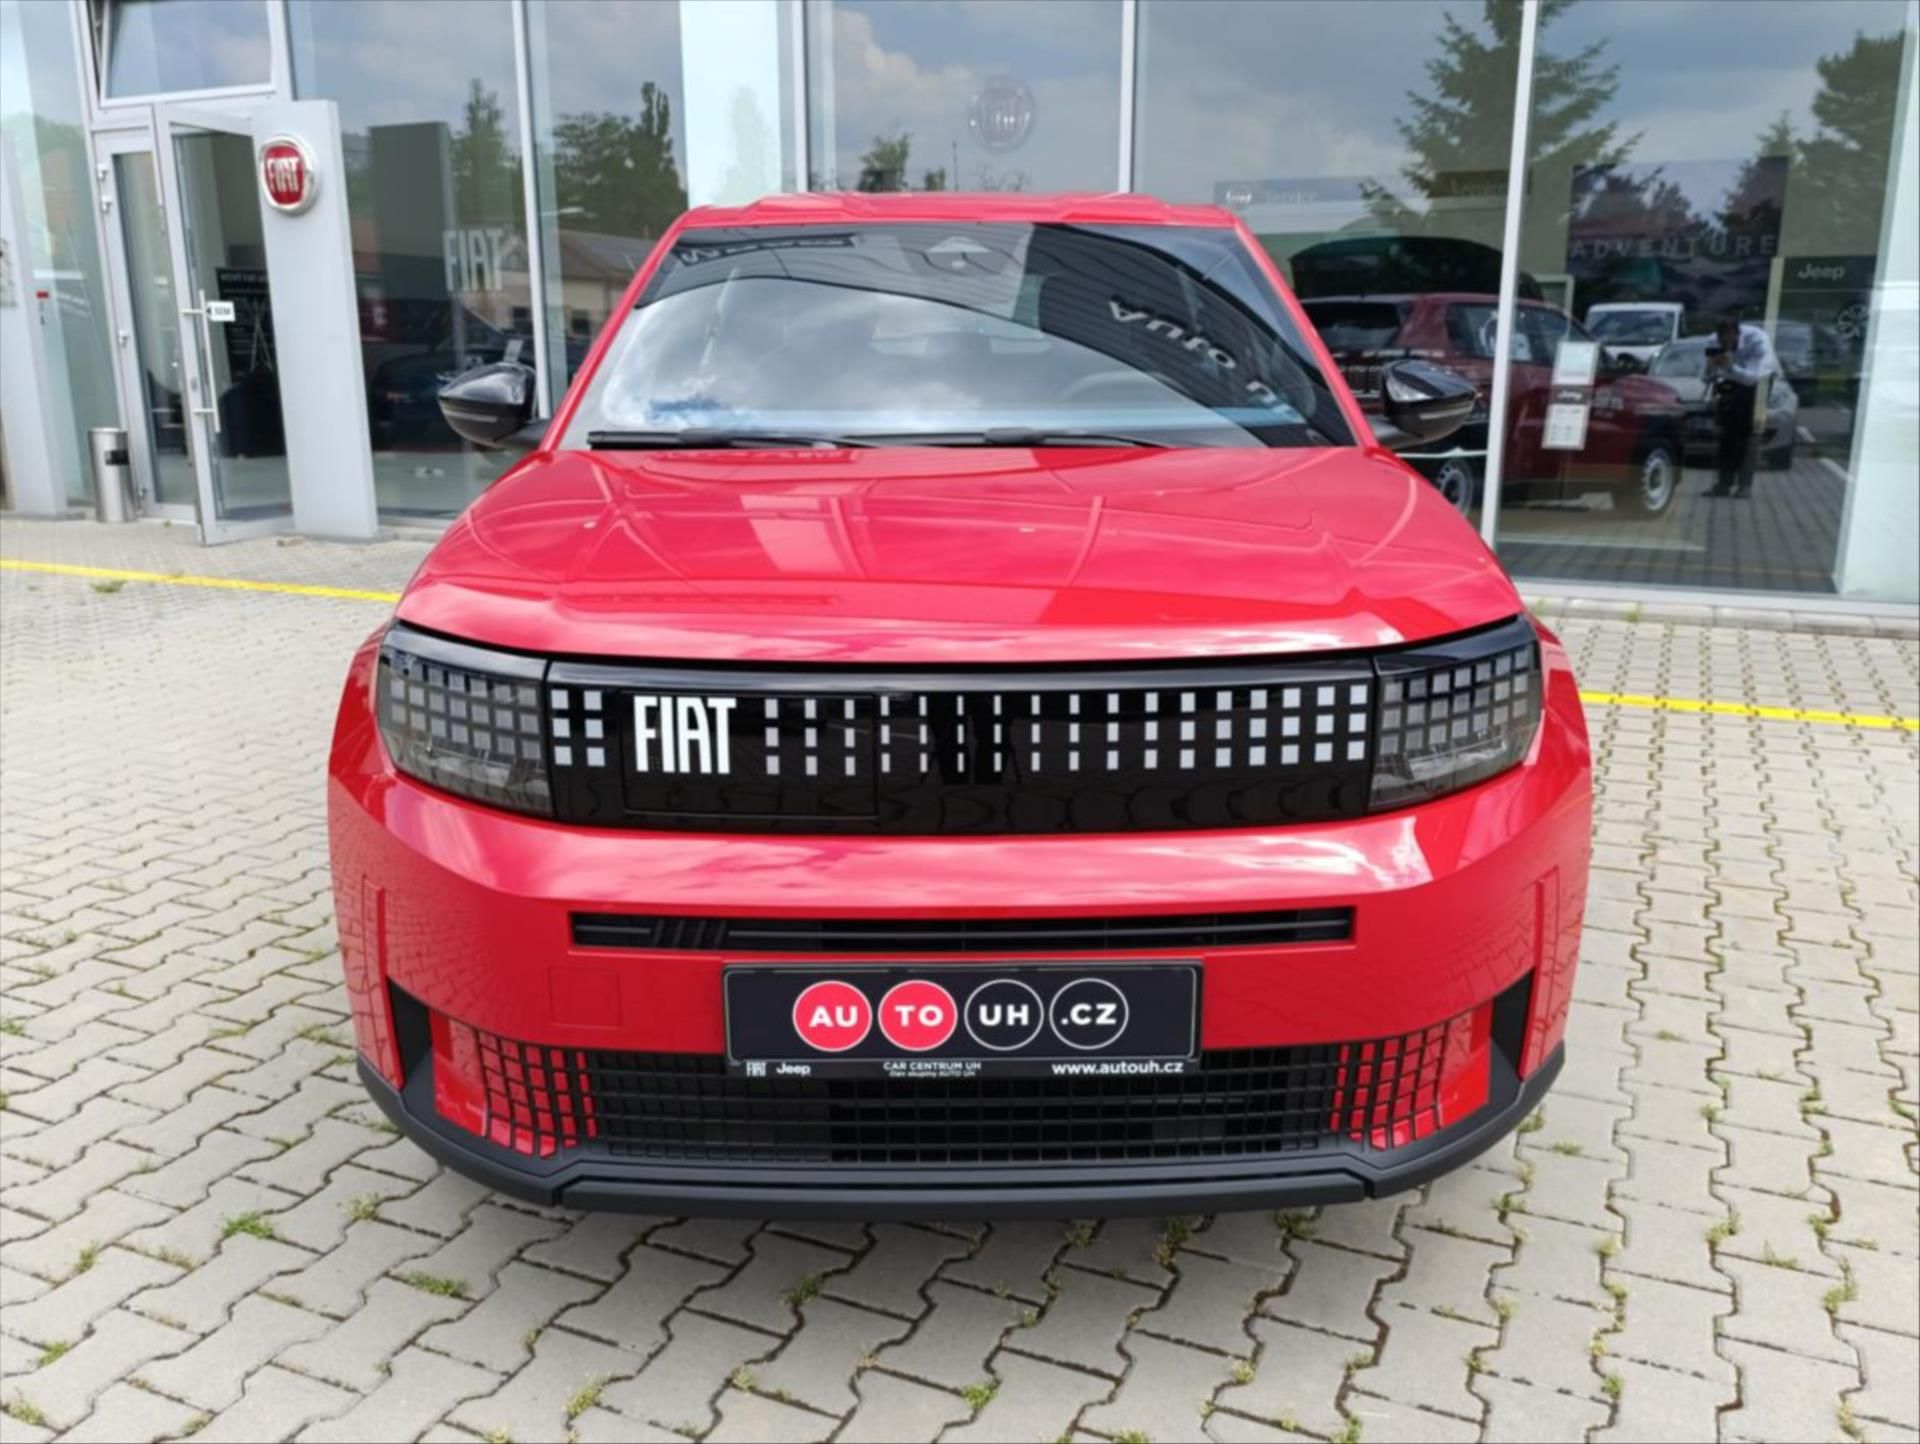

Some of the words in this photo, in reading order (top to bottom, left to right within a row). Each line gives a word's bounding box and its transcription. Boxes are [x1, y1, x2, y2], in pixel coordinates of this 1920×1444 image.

[267, 157, 299, 192] FIAT
[1571, 235, 1778, 258] ADVENTURE
[443, 229, 503, 291] FIAT
[1797, 263, 1845, 281] Jeep
[633, 695, 737, 774] FIAT
[808, 1005, 859, 1028] AU
[895, 1005, 944, 1027] TO
[979, 1004, 1029, 1025] UH
[1061, 1003, 1117, 1026] .CZ
[746, 1062, 766, 1077] FIAT
[776, 1063, 811, 1077] Jeep
[883, 1062, 907, 1070] CAR
[909, 1062, 962, 1070] CENTRUM
[965, 1061, 981, 1070] UH
[1051, 1061, 1184, 1075] www.autouh.cz
